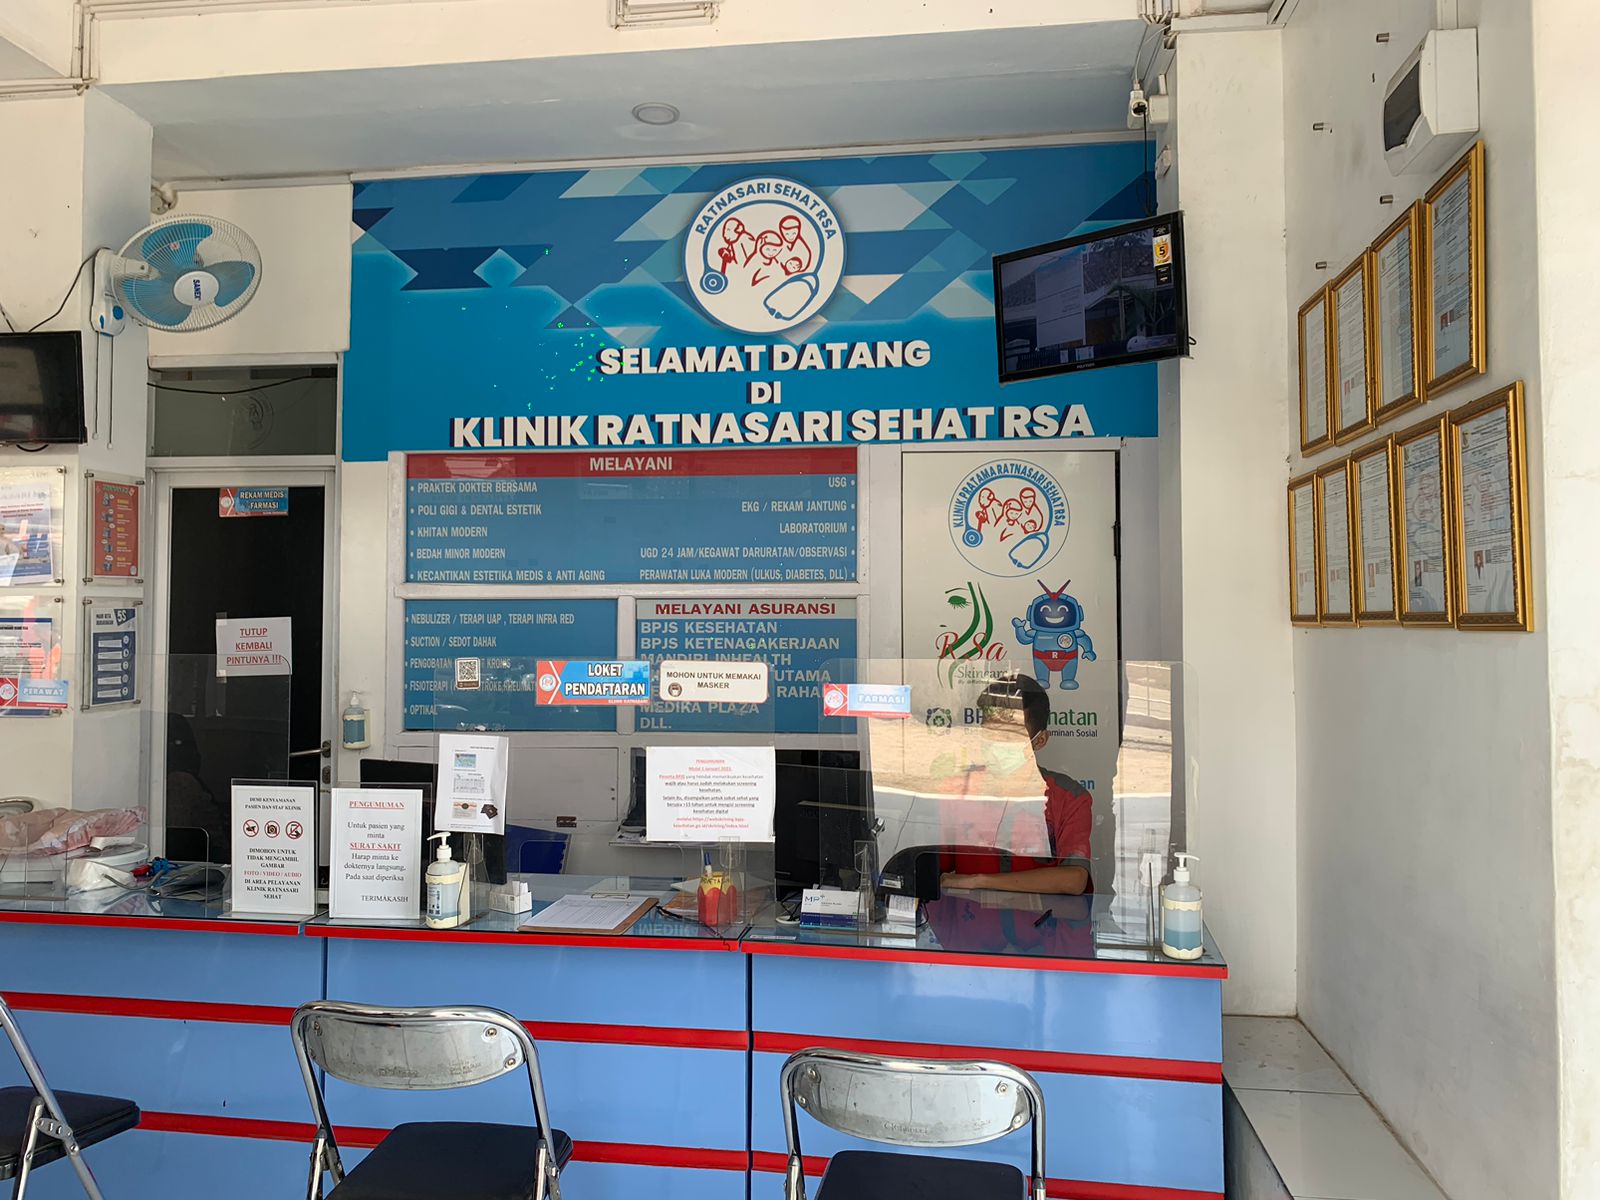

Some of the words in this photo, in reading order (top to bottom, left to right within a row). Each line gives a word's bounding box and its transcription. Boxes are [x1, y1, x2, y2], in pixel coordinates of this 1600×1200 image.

[695, 183, 770, 235] RATNASARI
[774, 184, 820, 211] SEHAT
[816, 209, 836, 239] RSA
[1160, 247, 1165, 255] 5
[598, 344, 766, 375] SELAMAT
[770, 340, 930, 371] DATANG
[748, 380, 782, 404] DI
[451, 415, 589, 448] KLINIK
[595, 410, 843, 446] RATNASARI
[849, 406, 994, 441] SEHAT
[1000, 403, 1095, 438] RSA
[590, 456, 673, 471] MELAYANI
[418, 482, 456, 493] PRAKTEK
[459, 482, 492, 493] DOKTER
[495, 482, 538, 493] BERSAMA
[828, 477, 846, 488] USG
[953, 498, 966, 528] KLINIK
[961, 466, 995, 498] PRATAMA
[997, 464, 1046, 486] RATNASARI
[1043, 481, 1064, 508] SEHAT
[1054, 508, 1066, 526] RSA
[418, 505, 437, 515] POLI
[440, 505, 458, 515] GIGI
[461, 506, 467, 515] &
[470, 504, 504, 515] DENTAL
[507, 504, 542, 515] ESTETIK
[741, 501, 759, 512] EKG
[763, 501, 768, 512] /
[771, 501, 803, 512] REKAM
[806, 500, 847, 511] JANTUNG
[417, 527, 448, 537] KHITAN
[451, 527, 488, 537] MODERN
[780, 523, 847, 533] LABORATORIUM
[416, 548, 442, 559] BEDAH
[444, 548, 470, 559] MINOR
[472, 548, 506, 559] MODERN
[640, 548, 658, 558] UGD
[662, 548, 674, 558] 24
[676, 547, 739, 558] JAM/KEGAWAT
[742, 546, 847, 558] DARURATAN/OBSERVASI
[417, 570, 470, 581] KECANTIKAN
[473, 570, 513, 581] ESTETIKA
[516, 570, 543, 581] MEDIS
[547, 571, 552, 580] &
[556, 570, 575, 581] ANTI
[578, 570, 605, 581] AGING
[640, 569, 688, 580] PERAWATAN
[691, 569, 710, 580] LUKA
[714, 569, 748, 580] MODERN
[751, 567, 783, 581] (ULKUS,
[786, 569, 826, 581] DIABETES,
[829, 567, 848, 581] DLL)
[655, 604, 741, 615] MELAYANI
[749, 603, 836, 615] ASURANSI
[117, 610, 126, 622] 5S
[411, 614, 450, 624] NEBULIZER
[459, 614, 484, 624] TERAPI
[487, 614, 501, 624] UAP
[509, 614, 534, 624] TERAPI
[536, 614, 557, 624] INFRA
[560, 614, 575, 624] RED
[240, 628, 268, 637] TUTUP
[640, 622, 678, 634] BPJS
[684, 622, 777, 634] KESEHATAN
[235, 642, 272, 651] KEMBALI
[411, 636, 440, 647] SUCTION
[448, 637, 471, 647] SEDOT
[473, 637, 496, 647] DAHAK
[640, 638, 678, 649] BPJS
[684, 638, 840, 650] KETENAGAKERJAAN
[226, 656, 269, 665] PINTUNYA
[410, 658, 453, 668] PENGOBATAN
[588, 664, 623, 677] LOKET
[666, 671, 695, 679] MOHON
[774, 670, 831, 682] UTAMA
[23, 687, 64, 696] PERAWAT
[410, 680, 448, 692] FISIOTERAPI
[565, 683, 645, 696] PENDAFTARAN
[777, 686, 823, 698] RAHA
[858, 694, 905, 704] FARMASI
[410, 705, 438, 715] OPTIKAL
[640, 702, 701, 713] MEDIKA
[708, 702, 760, 713] PLAZA
[640, 718, 672, 729] DLL.
[1076, 729, 1097, 737] Sosial
[349, 801, 405, 809] PENGUMUMAN
[368, 822, 388, 830] pasien
[352, 853, 371, 861] Harap
[376, 874, 404, 882] diperiksa
